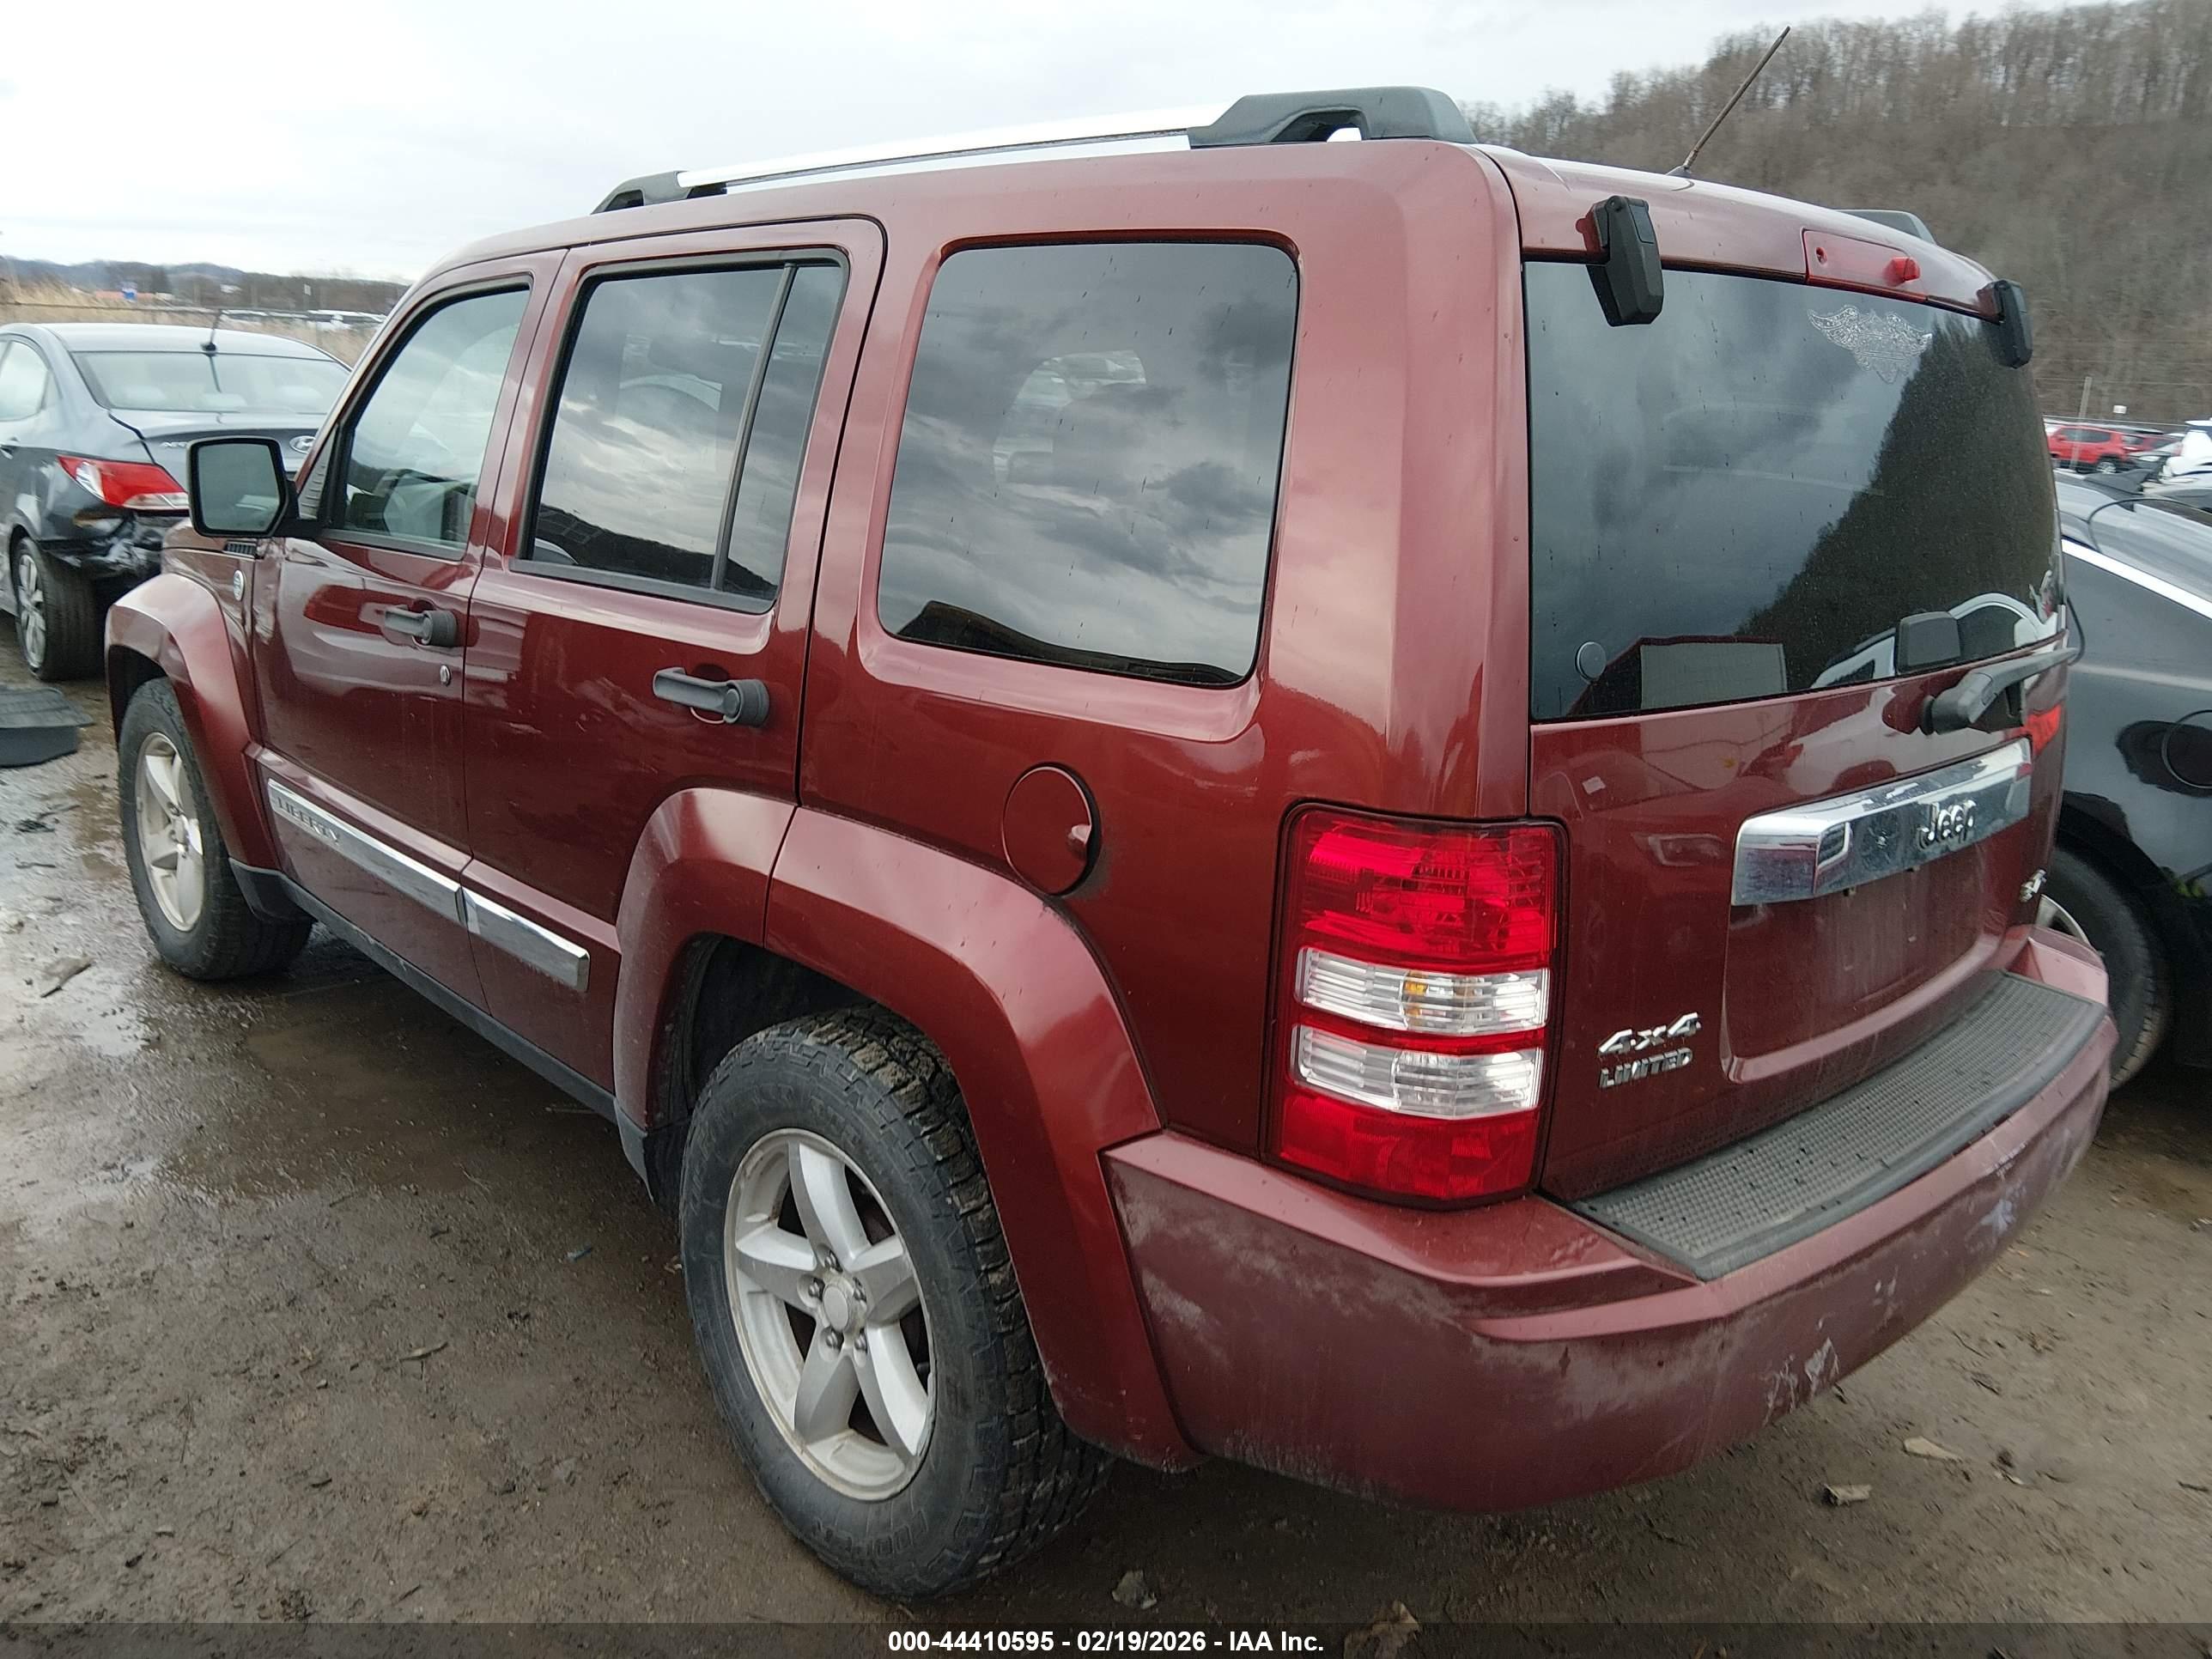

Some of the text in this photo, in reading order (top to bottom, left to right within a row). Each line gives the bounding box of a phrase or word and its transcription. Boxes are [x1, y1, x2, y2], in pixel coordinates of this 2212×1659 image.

[276, 796, 341, 846] LIBERTY
[1917, 799, 1977, 850] Jeep
[1599, 1047, 1692, 1089] LIMITED
